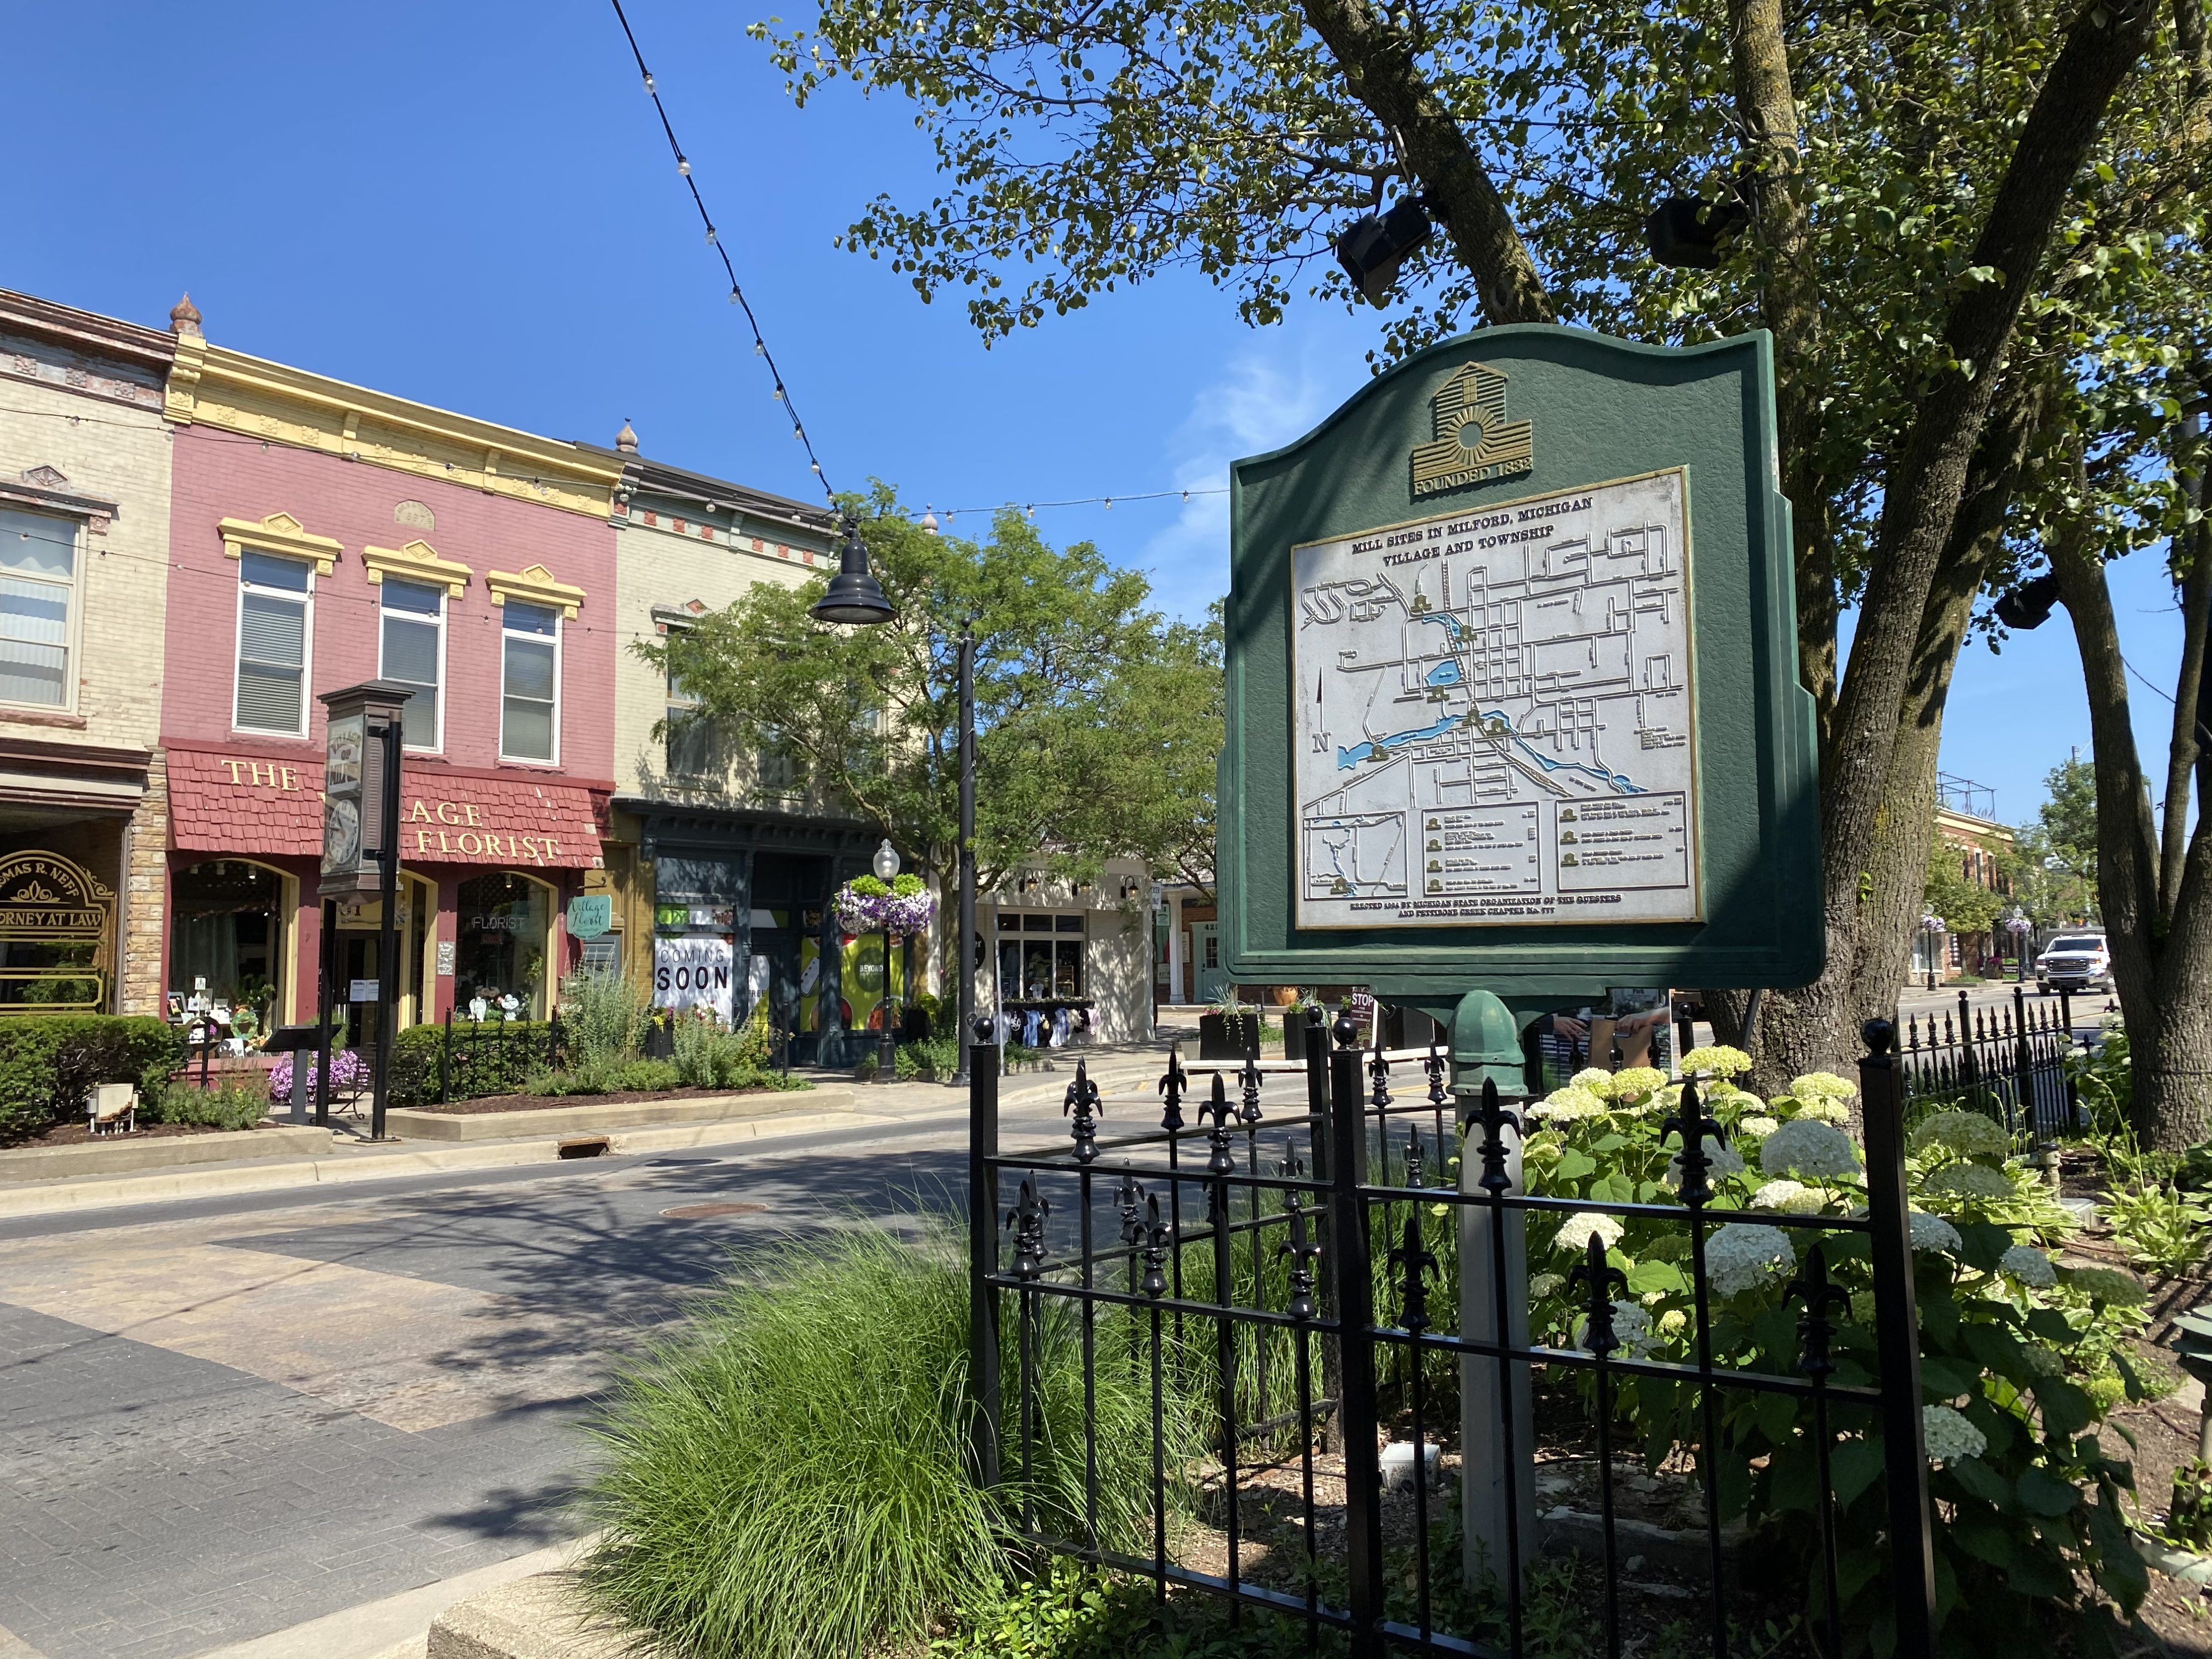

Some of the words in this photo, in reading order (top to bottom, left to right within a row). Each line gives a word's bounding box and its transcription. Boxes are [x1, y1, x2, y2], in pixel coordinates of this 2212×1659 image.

[1413, 467, 1491, 495] FOUNDED
[1495, 457, 1533, 477] 1832
[1352, 539, 1383, 555] MILL
[1386, 529, 1423, 549] SITES
[1427, 525, 1443, 540] IN
[1447, 513, 1514, 536] MILFORD,
[1517, 497, 1594, 523] MICHIGAN
[1383, 546, 1441, 567] VILLAGE
[1444, 540, 1474, 555] AND
[1478, 524, 1555, 549] TOWNSHIP
[1312, 731, 1332, 753] N
[221, 760, 299, 791] THE
[416, 831, 559, 860] FLORIST
[50, 867, 80, 897] NEFF
[571, 900, 604, 916] Village
[1350, 902, 1383, 911] ERECTED
[1400, 900, 1413, 910] BY
[1413, 899, 1452, 909] MICHIGAN
[1453, 899, 1479, 907] STATE
[1480, 896, 1543, 906] ORGANIZATION
[1543, 896, 1556, 905] OF
[1557, 895, 1575, 904] THE
[1576, 894, 1622, 904] QUESTERS
[46, 913, 66, 926] AT
[69, 913, 102, 926] LAW
[571, 911, 604, 927] Florist
[1398, 910, 1415, 918] AND
[1459, 907, 1486, 916] CREEK
[1488, 907, 1525, 916] CHAPTER
[1526, 907, 1540, 915] No.
[472, 916, 526, 929] FLORIST
[661, 949, 724, 963] COMING
[656, 966, 728, 991] SOON
[1352, 993, 1374, 1006] STOP
